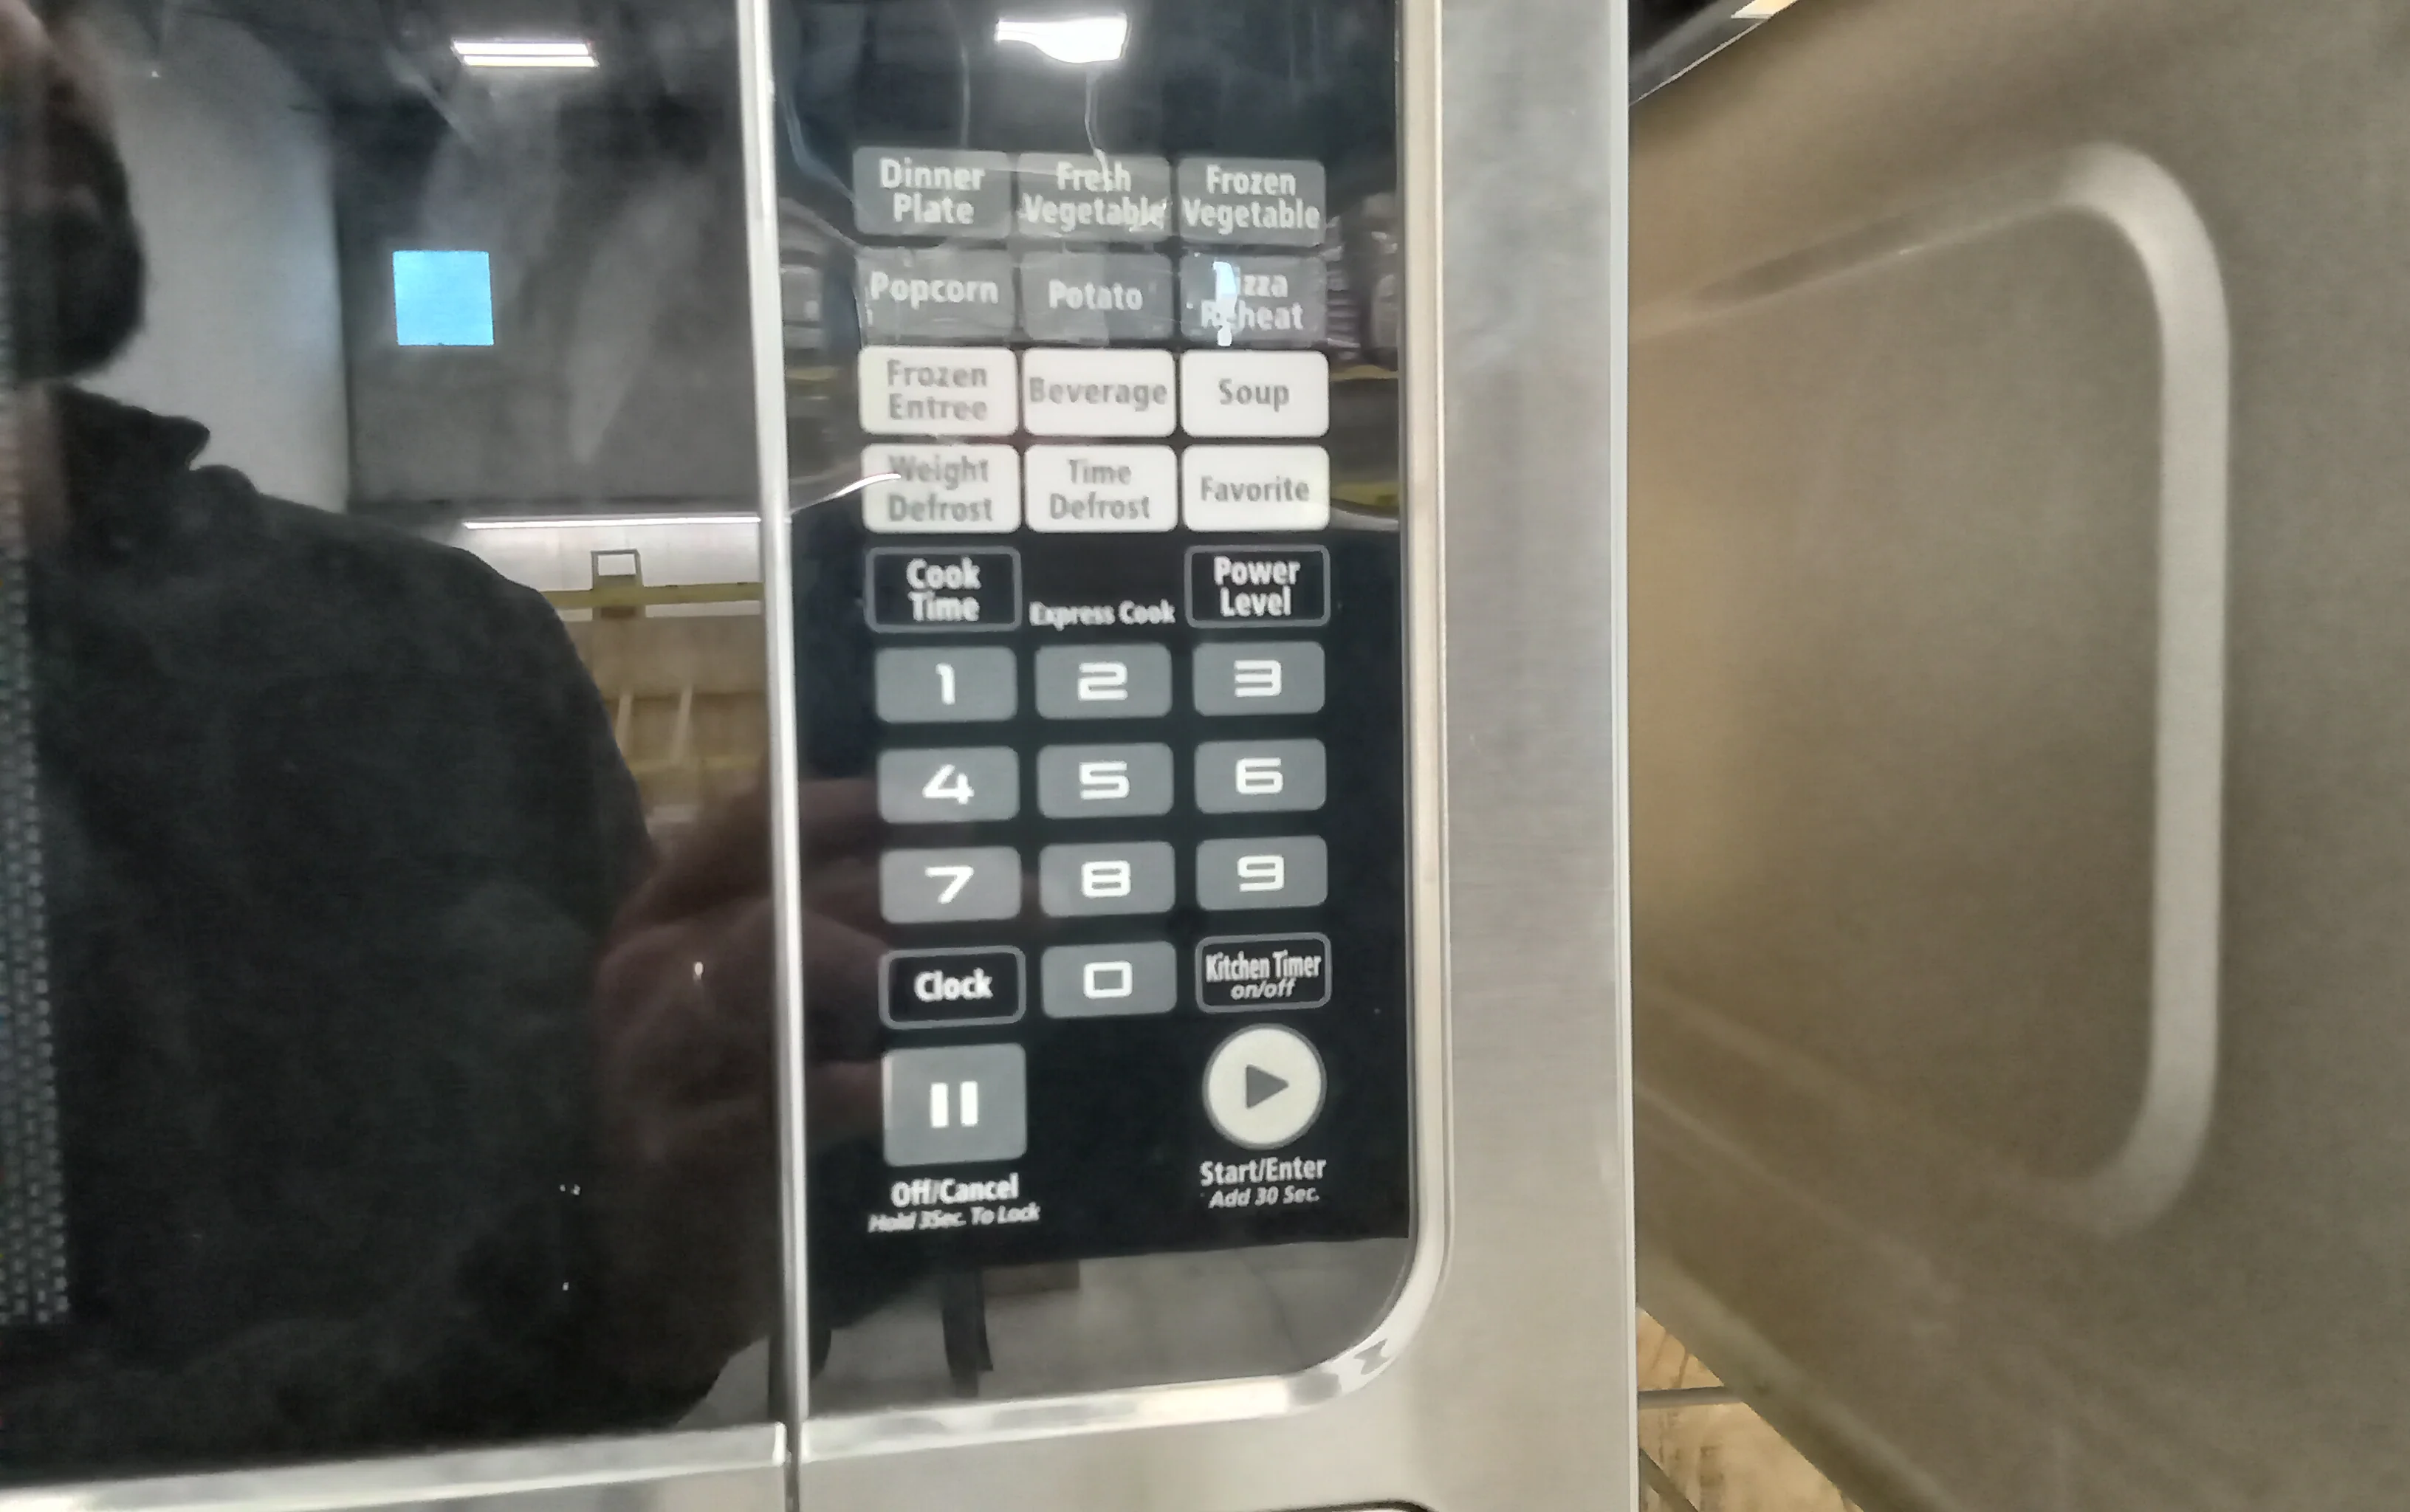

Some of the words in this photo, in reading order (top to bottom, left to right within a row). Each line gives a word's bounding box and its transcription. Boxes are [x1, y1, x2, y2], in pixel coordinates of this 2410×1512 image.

[879, 157, 985, 190] Dinner
[1057, 160, 1131, 192] Fresh
[1206, 165, 1296, 196] Frozen
[893, 193, 974, 224] Plate
[1023, 193, 1164, 232] Vegetable
[1182, 199, 1320, 234] Vegetable
[871, 272, 998, 309] Popcorn
[1049, 281, 1143, 311] Potato
[887, 360, 987, 389] Frozen
[889, 393, 988, 421] Entree
[1029, 377, 1167, 411] Beverage
[1218, 379, 1289, 411] Soup
[889, 456, 989, 489] Weight
[1068, 458, 1132, 485] Time
[1201, 475, 1309, 503] Favorite
[888, 493, 992, 522] Defrost
[1050, 492, 1150, 520] Defrost
[906, 557, 981, 591] Cook
[1213, 555, 1301, 587] Power
[910, 591, 980, 622] Time
[1029, 601, 1114, 630] Express
[1119, 600, 1175, 625] Cook
[1220, 587, 1291, 617] Level
[935, 662, 955, 705] 1
[1077, 662, 1128, 701] 2
[1234, 660, 1282, 698] 3
[922, 764, 975, 805] 4
[1079, 760, 1130, 800] 5
[1235, 757, 1283, 794] 6
[924, 865, 974, 904] 7
[1081, 860, 1131, 897] 8
[1237, 855, 1285, 893] 9
[1083, 961, 1133, 999] 0
[1206, 951, 1270, 982] Kitchen
[1272, 948, 1322, 978] Timer
[913, 968, 993, 1003] Clock
[1230, 977, 1297, 1000] on/off
[1200, 1156, 1326, 1186] Start/Enter
[890, 1172, 1019, 1208] Off/Cancel
[1209, 1187, 1250, 1209] Add
[1255, 1187, 1278, 1205] 30
[1283, 1185, 1319, 1203] Sec.
[970, 1206, 995, 1226] To
[997, 1201, 1040, 1224] Lock
